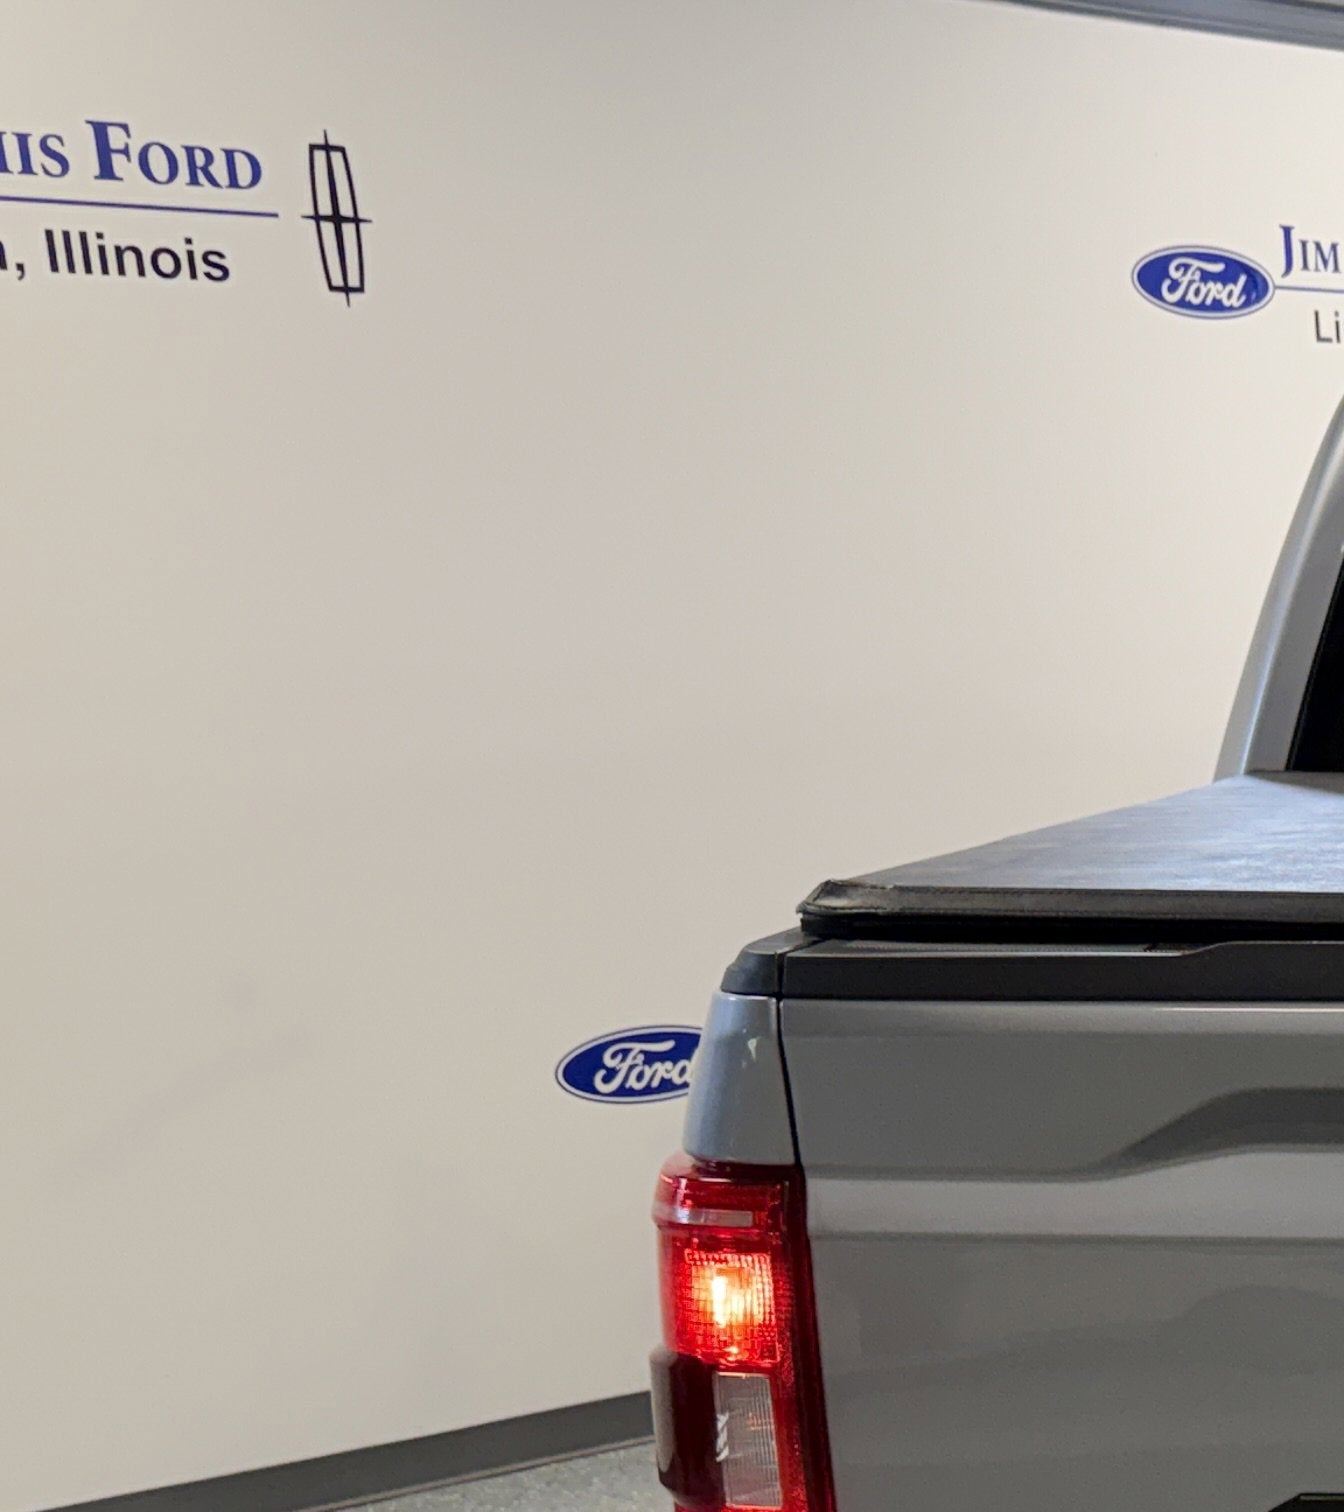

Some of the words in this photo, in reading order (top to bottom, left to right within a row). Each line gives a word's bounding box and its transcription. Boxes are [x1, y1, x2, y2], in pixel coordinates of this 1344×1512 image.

[84, 119, 263, 190] FORD
[44, 228, 231, 282] Illinois
[1279, 224, 1340, 279] JIM
[1160, 256, 1248, 309] Ford
